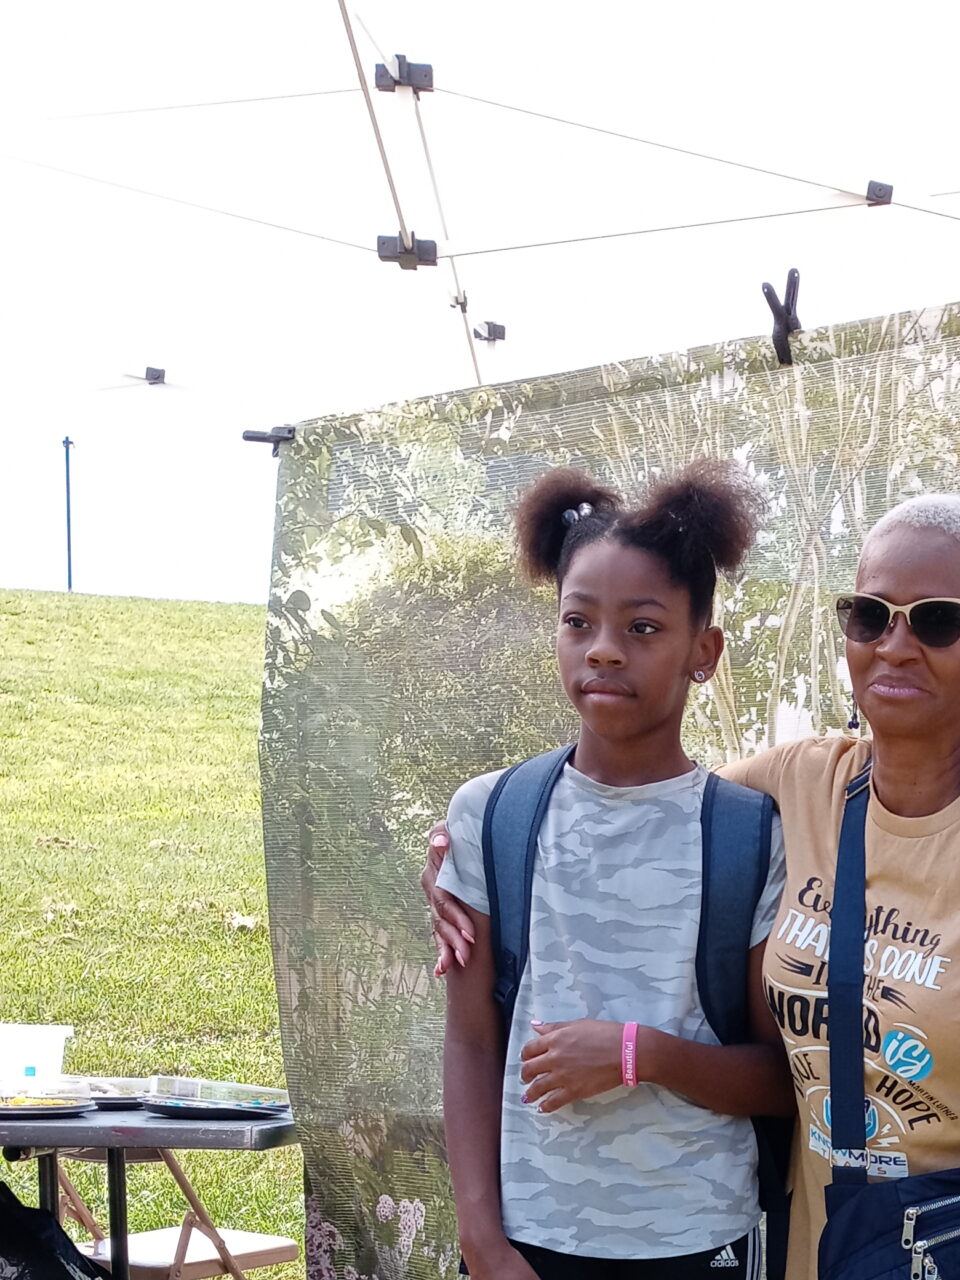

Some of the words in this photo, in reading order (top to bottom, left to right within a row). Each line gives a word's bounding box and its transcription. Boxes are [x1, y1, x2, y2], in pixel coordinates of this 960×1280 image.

[776, 907, 831, 962] THA
[876, 943, 952, 992] DONE
[764, 976, 882, 1055] WORD
[625, 1041, 634, 1080] Beautiful
[884, 1030, 931, 1078] is
[874, 1073, 943, 1132] HOPE
[907, 1079, 934, 1102] MARTIN
[931, 1099, 959, 1121] LUTHER
[710, 1259, 739, 1268] adidas
